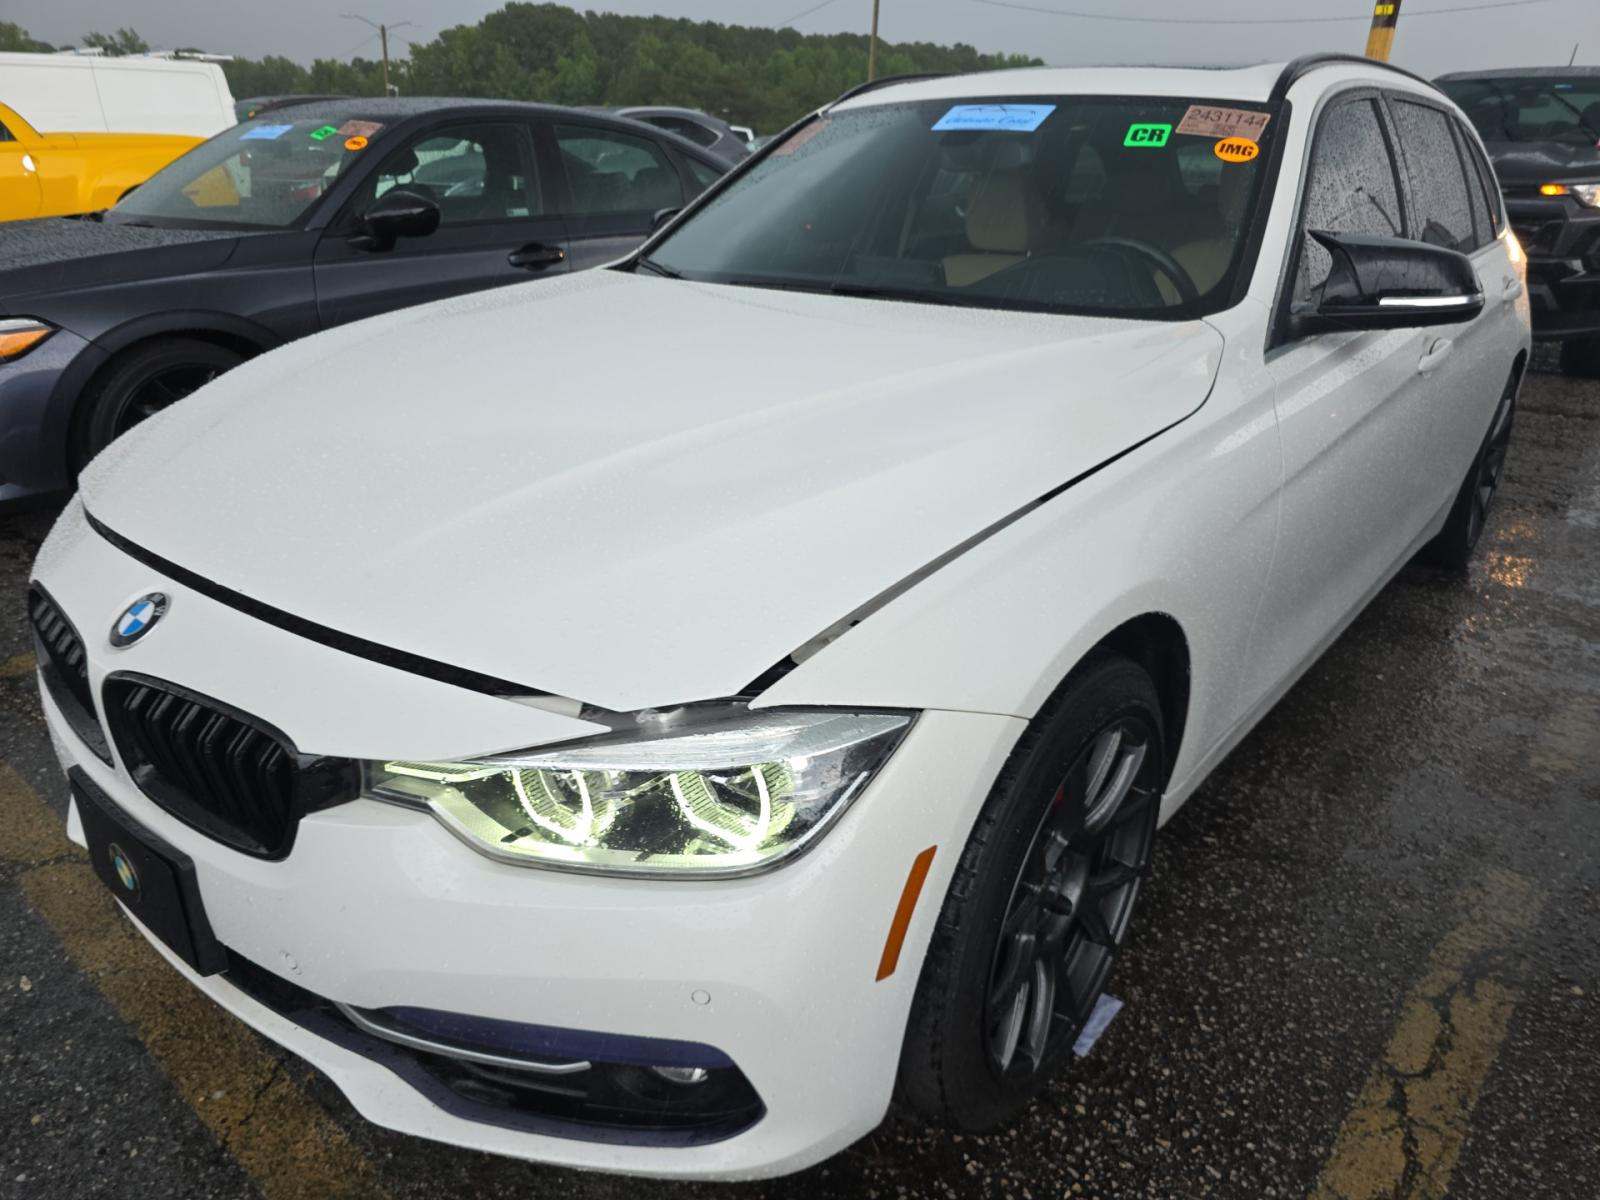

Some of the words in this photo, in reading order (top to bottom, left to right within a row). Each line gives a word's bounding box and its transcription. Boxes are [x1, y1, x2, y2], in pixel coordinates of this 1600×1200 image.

[1187, 108, 1267, 127] 2431144
[1130, 127, 1166, 143] CR
[1218, 143, 1254, 157] IMG
